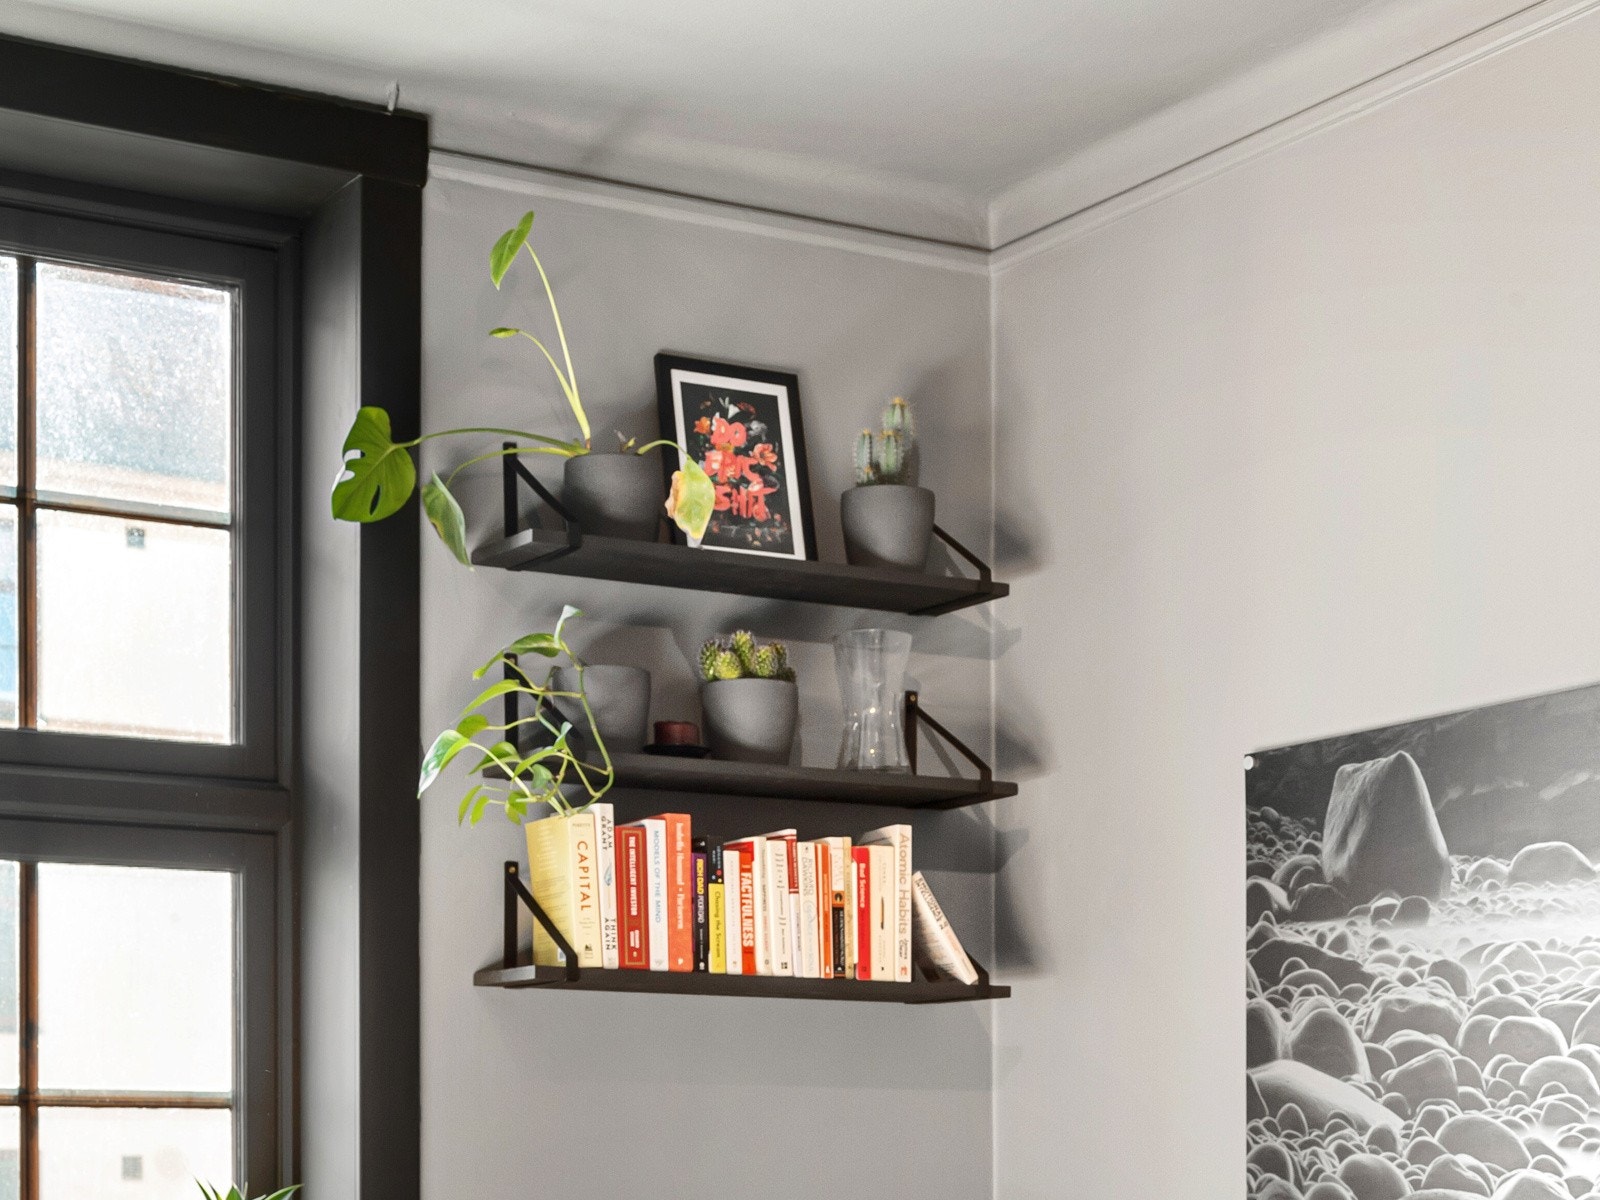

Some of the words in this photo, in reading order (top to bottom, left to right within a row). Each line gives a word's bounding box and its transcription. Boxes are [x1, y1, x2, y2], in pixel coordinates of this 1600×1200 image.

[711, 414, 747, 448] DO
[713, 485, 778, 522] SHIT
[577, 840, 592, 911] CAPITAL
[654, 866, 661, 879] OF
[899, 834, 909, 884] Atomic
[741, 872, 754, 947] FACTFULNESS
[899, 890, 909, 934] Habits
